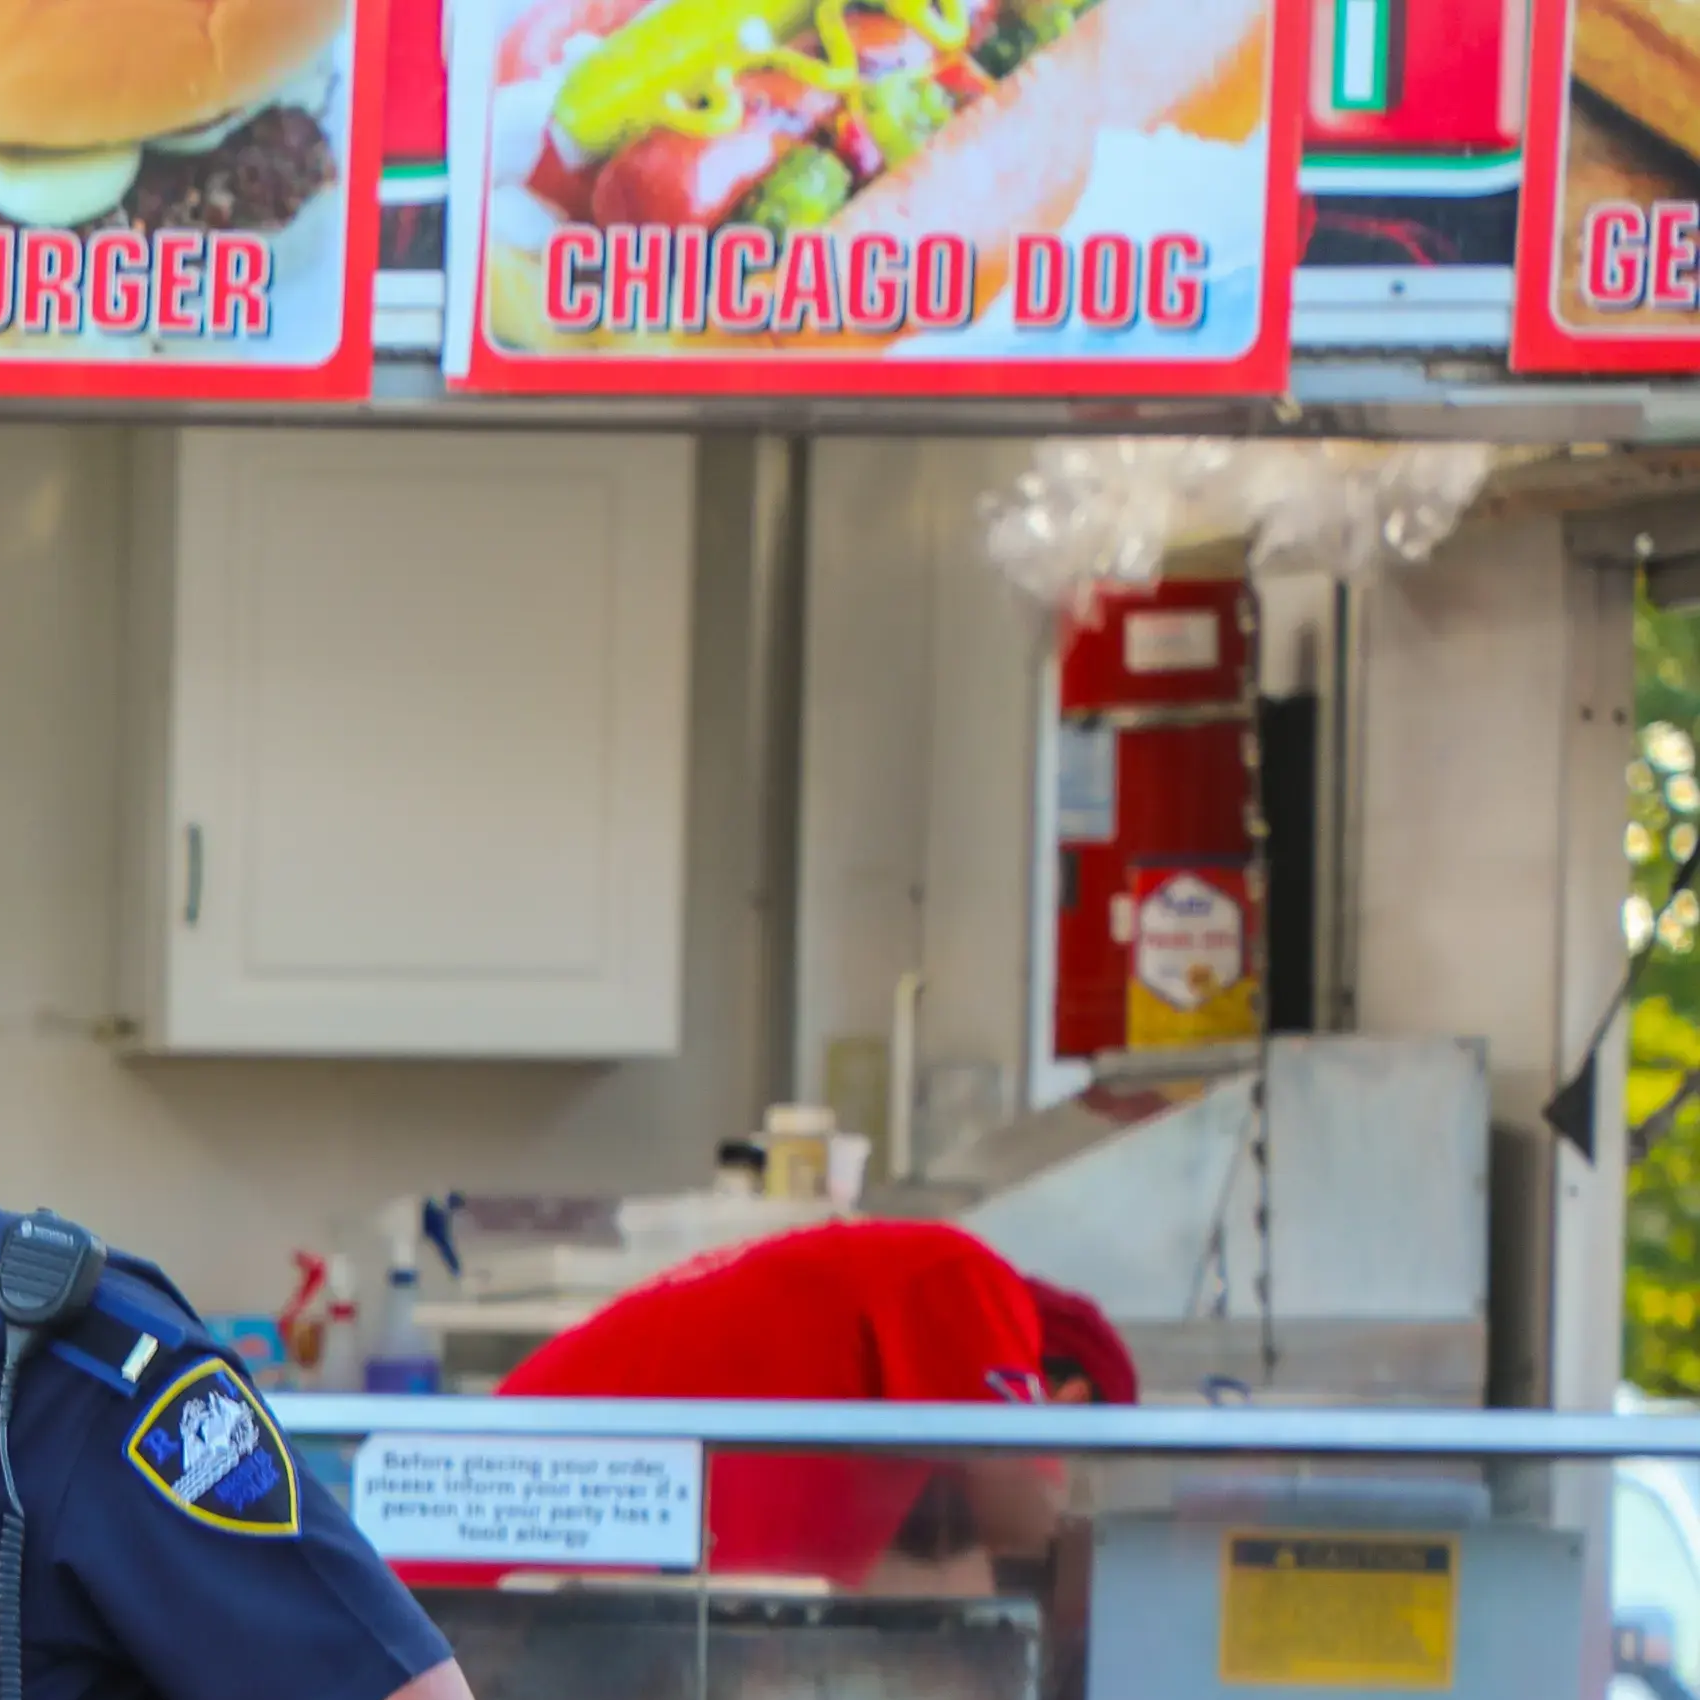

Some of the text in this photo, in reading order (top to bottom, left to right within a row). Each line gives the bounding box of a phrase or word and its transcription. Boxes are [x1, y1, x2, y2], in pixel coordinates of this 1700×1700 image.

[544, 228, 1206, 330] CHICAGO DOG
[383, 1451, 455, 1470] Before
[463, 1454, 542, 1480] placing
[551, 1457, 600, 1478] your
[365, 1474, 689, 1503] please inform your server if a
[381, 1500, 671, 1527] person in your party has a
[458, 1522, 590, 1549] food allergy
